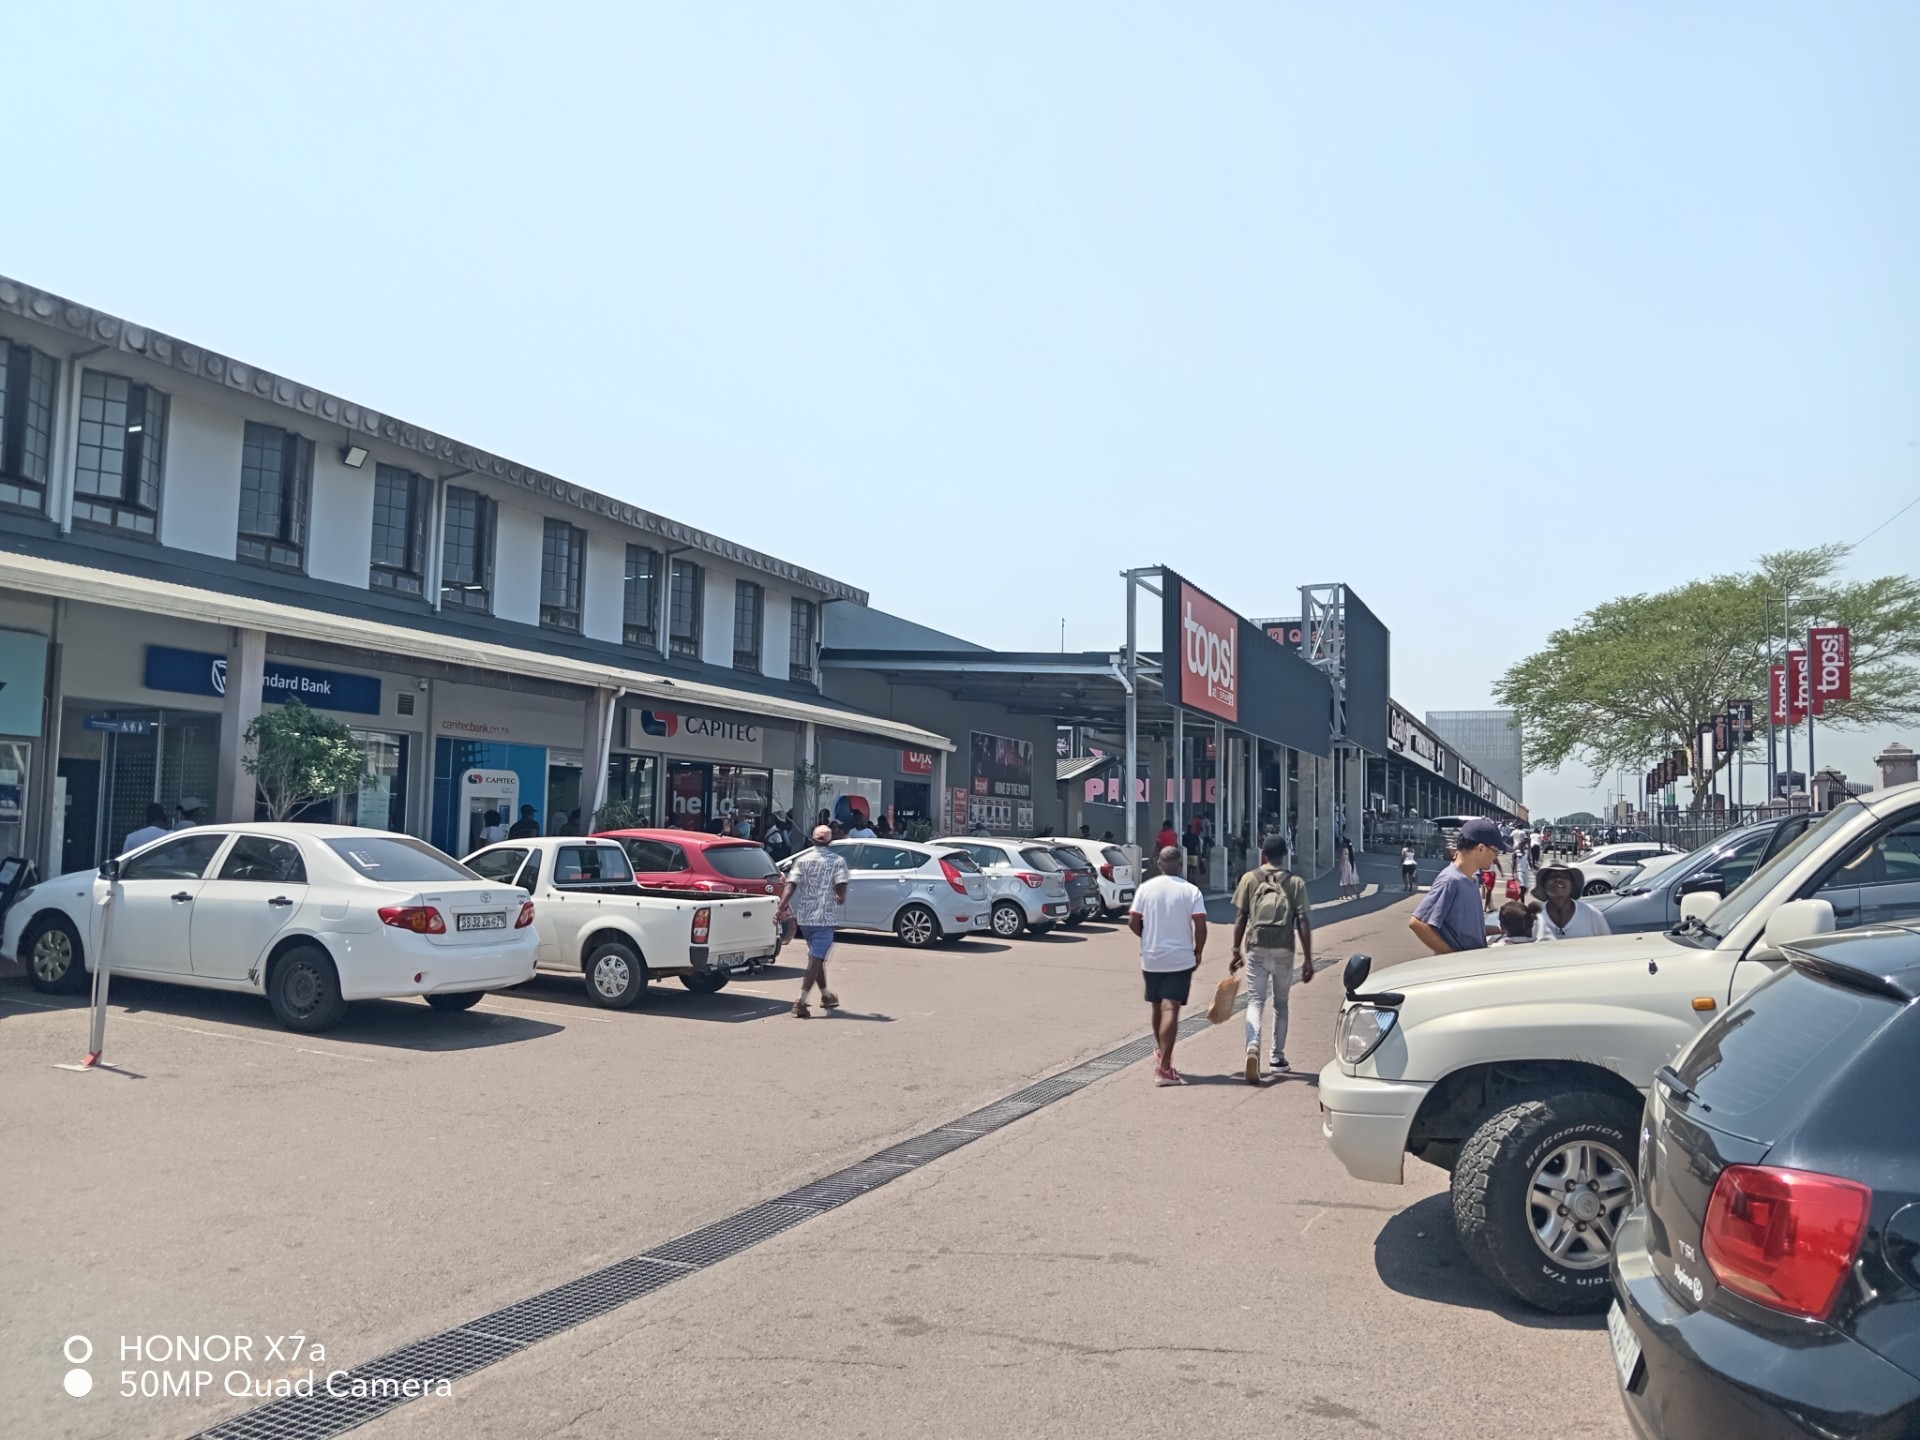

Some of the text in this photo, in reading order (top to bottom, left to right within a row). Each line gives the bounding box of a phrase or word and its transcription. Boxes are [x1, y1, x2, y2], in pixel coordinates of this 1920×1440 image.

[1184, 600, 1235, 698] tops!
[1816, 634, 1845, 693] tops!
[262, 673, 331, 694] ndard Bank
[685, 715, 757, 743] CAPITEC
[485, 776, 516, 785] CAPITEC
[1084, 778, 1227, 804] PARIG
[673, 790, 735, 816] helo
[1525, 1124, 1624, 1169] BFGoodrich
